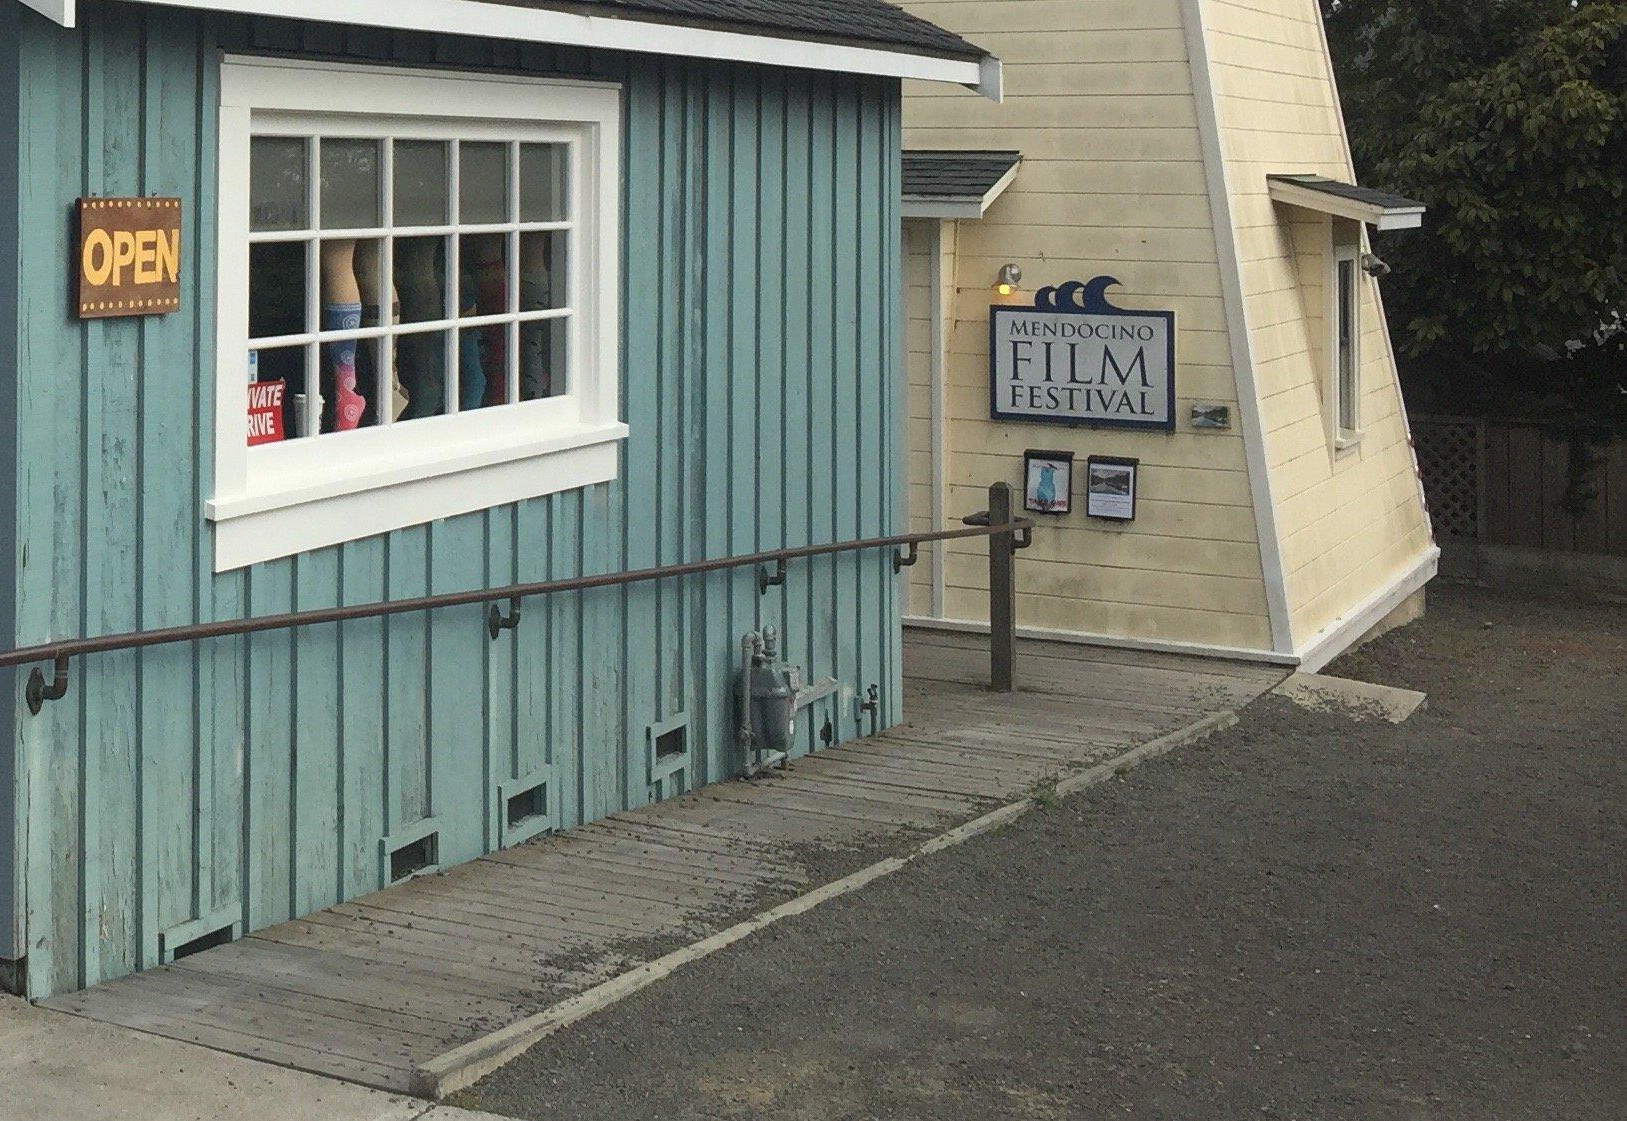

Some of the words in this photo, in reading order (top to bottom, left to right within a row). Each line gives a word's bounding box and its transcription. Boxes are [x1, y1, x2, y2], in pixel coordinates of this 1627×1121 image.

[82, 228, 180, 286] OPEN
[1010, 319, 1154, 341] MENDOCINO
[1009, 341, 1154, 387] FILM
[1010, 385, 1154, 415] FESTIVAL
